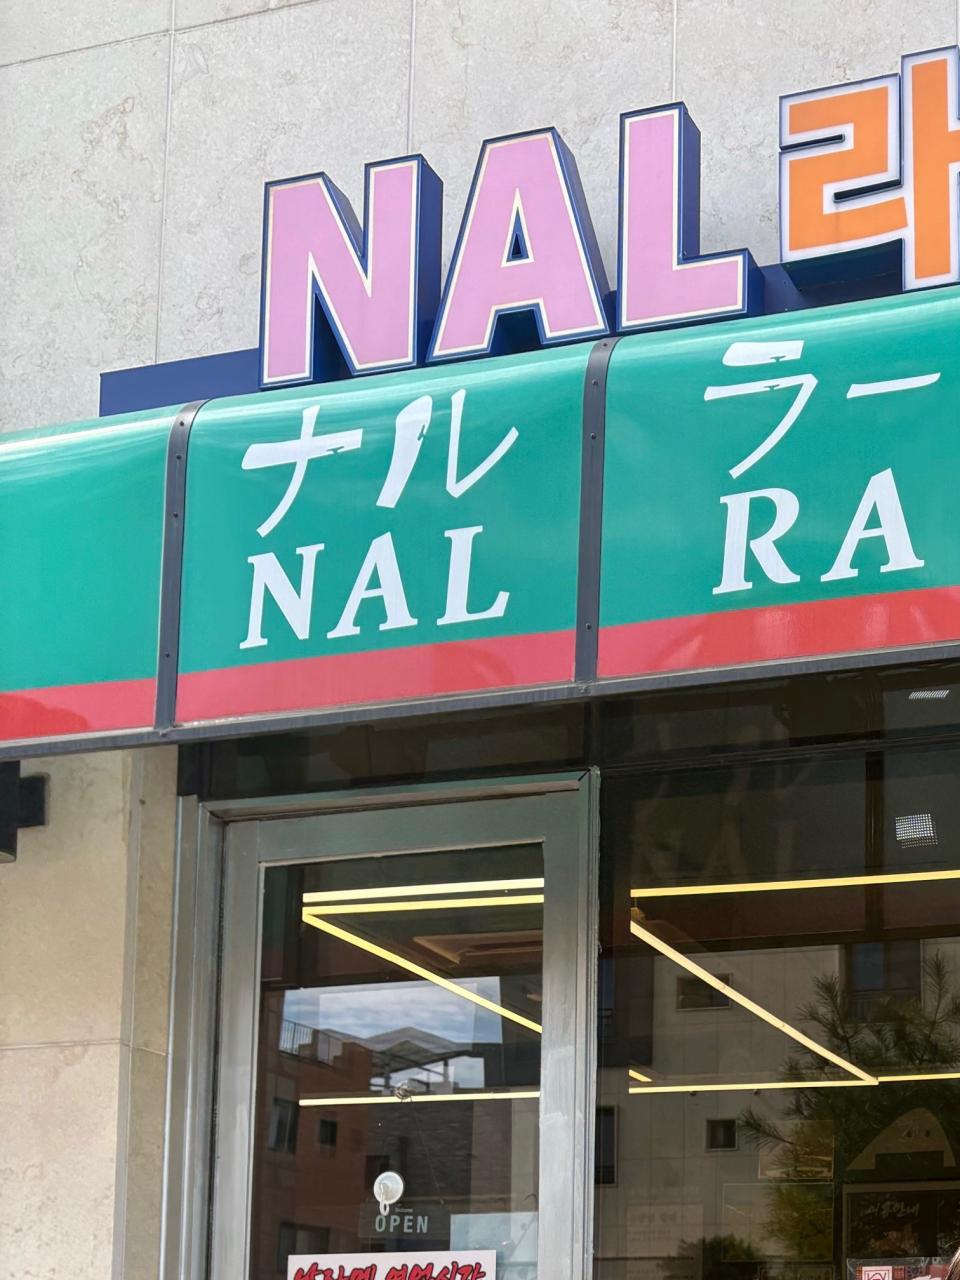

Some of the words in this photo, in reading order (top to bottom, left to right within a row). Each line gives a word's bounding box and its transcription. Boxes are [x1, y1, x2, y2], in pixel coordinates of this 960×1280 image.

[260, 102, 753, 388] NAL
[241, 389, 519, 538] ナル
[704, 340, 941, 478] ラー
[239, 525, 510, 651] NAL
[712, 467, 925, 595] RA
[375, 1214, 429, 1233] OPEN
